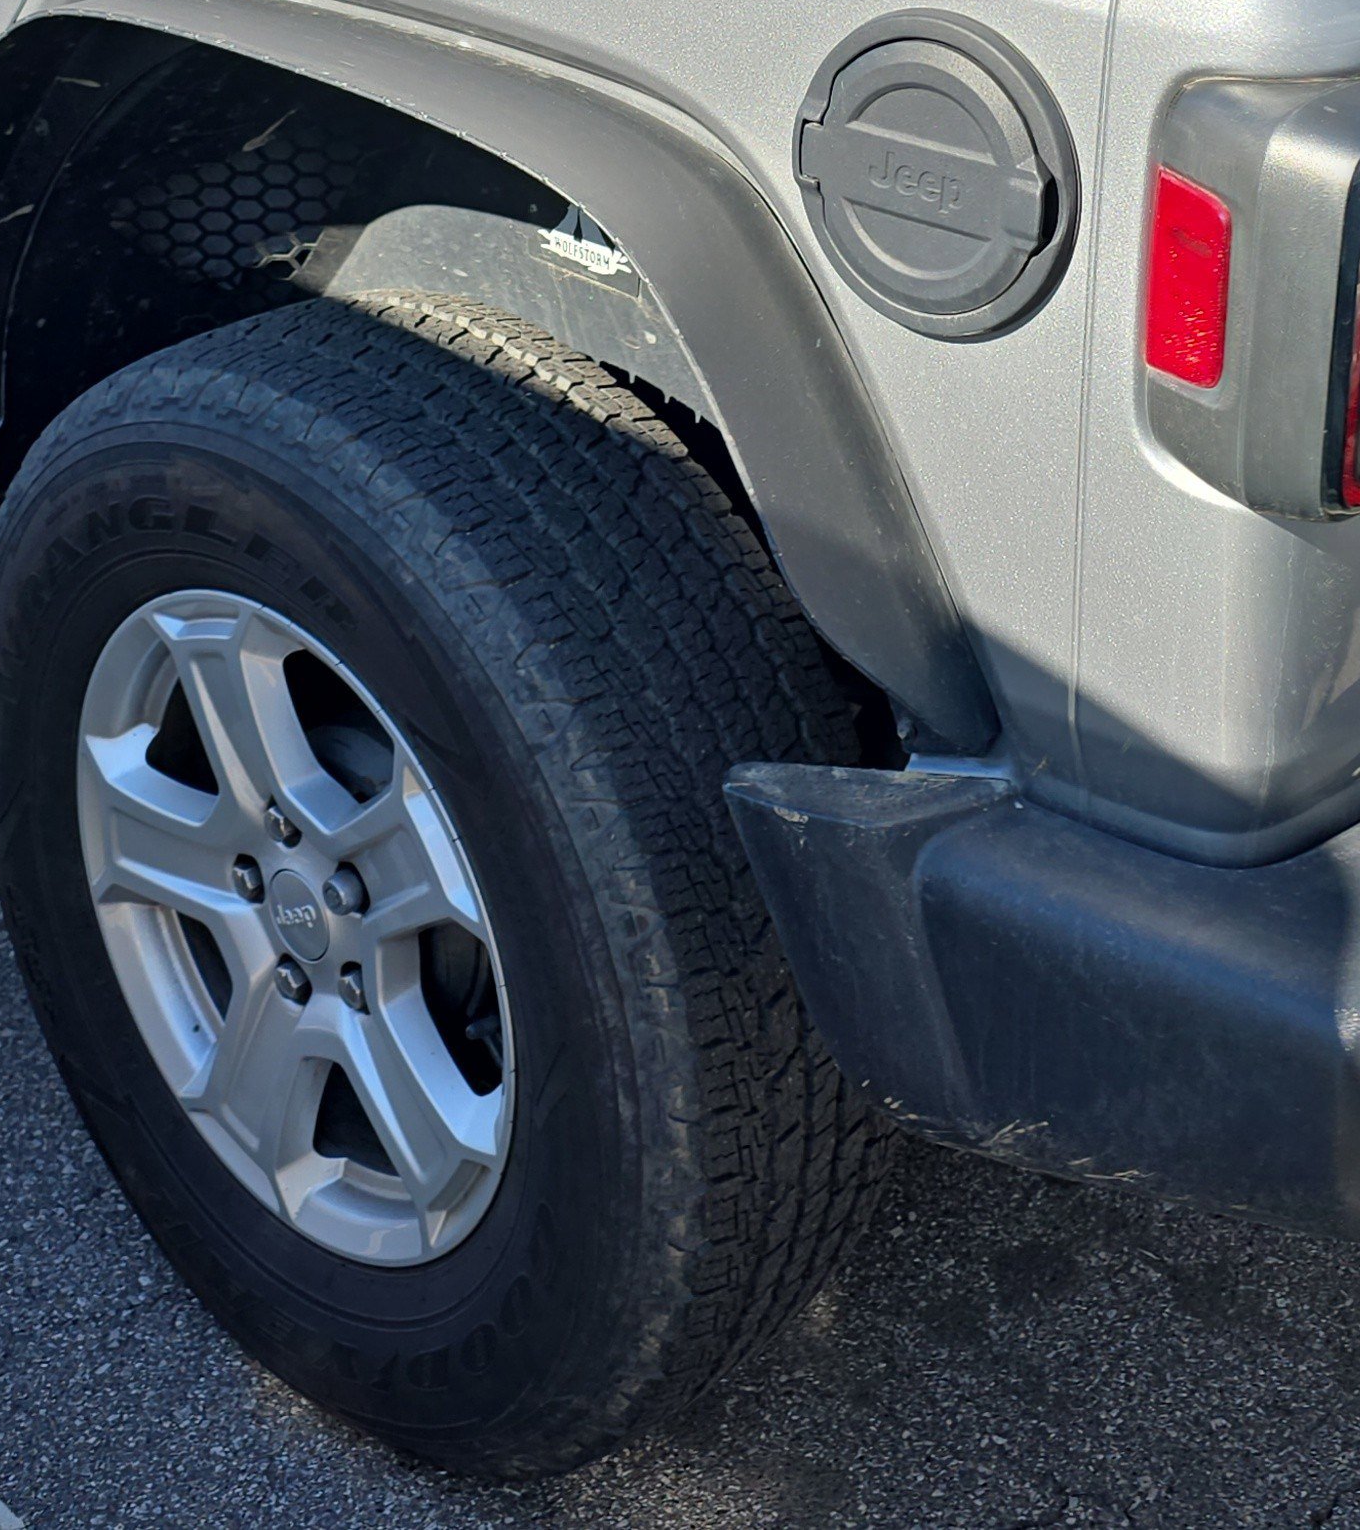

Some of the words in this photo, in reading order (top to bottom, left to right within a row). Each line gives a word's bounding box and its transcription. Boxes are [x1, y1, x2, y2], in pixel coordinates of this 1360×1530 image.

[868, 151, 962, 215] Jeep
[554, 236, 611, 270] WOLFSTORM
[275, 903, 318, 929] Jeep
